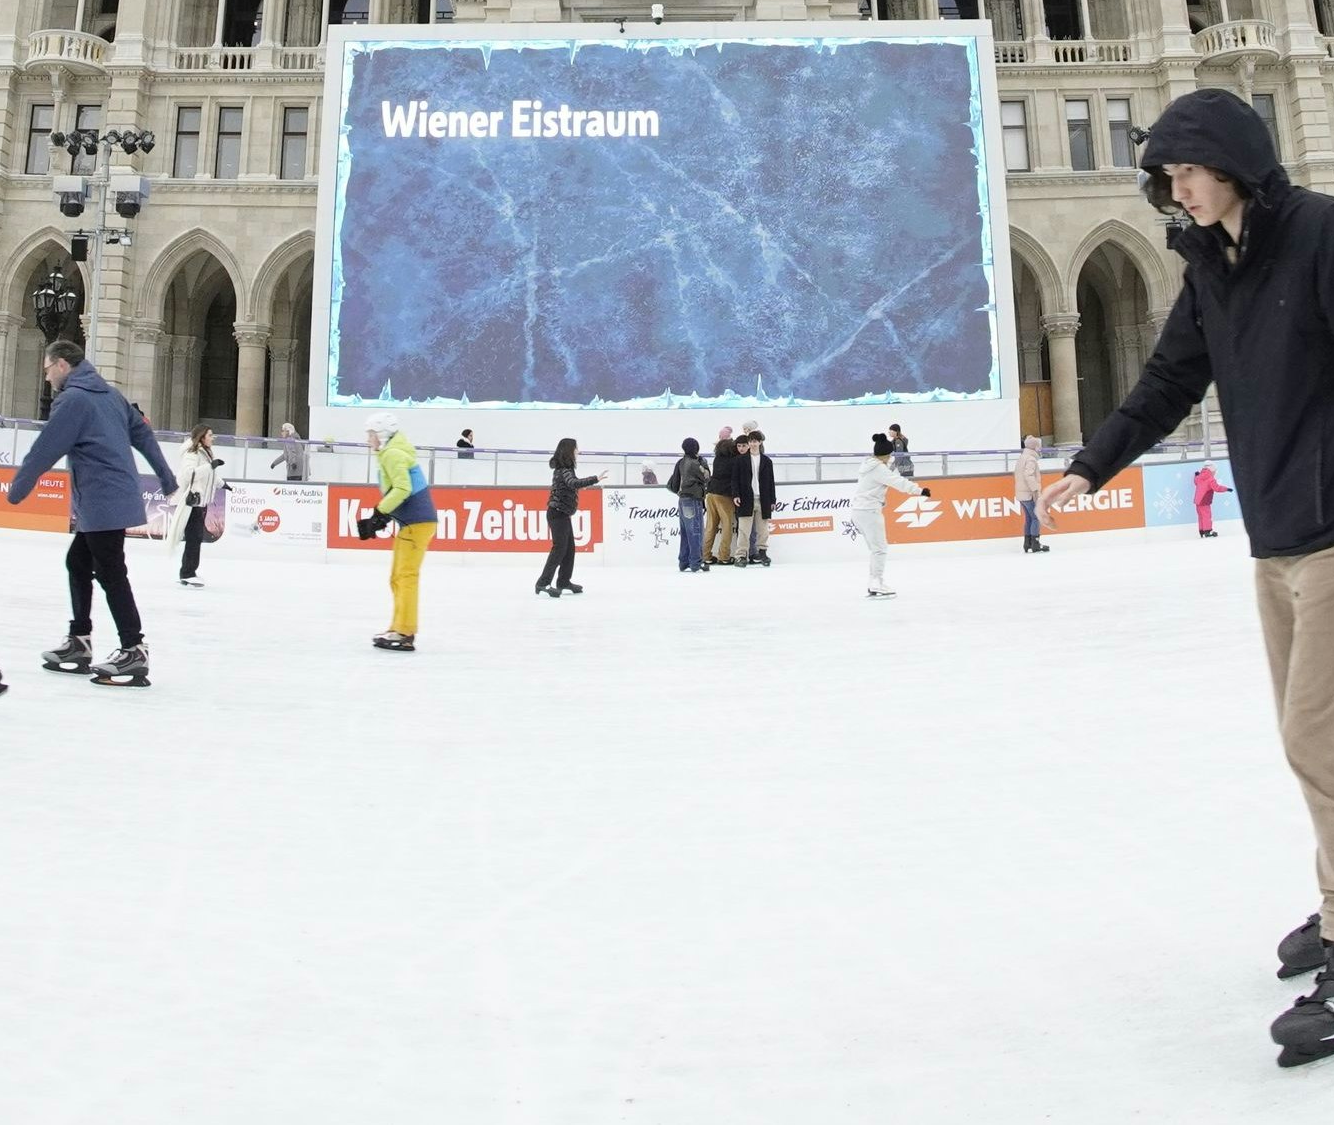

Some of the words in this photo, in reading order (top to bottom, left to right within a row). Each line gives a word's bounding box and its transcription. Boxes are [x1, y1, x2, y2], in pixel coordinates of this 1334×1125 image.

[381, 100, 503, 138] Wiener
[511, 100, 659, 138] Eistraum
[39, 480, 64, 488] HEUTE
[281, 488, 298, 496] Bank
[299, 489, 323, 497] Austria
[230, 496, 266, 505] GoGreen
[952, 497, 1022, 520] WIEN
[463, 499, 592, 547] Zeitug
[778, 521, 799, 530] WIEN
